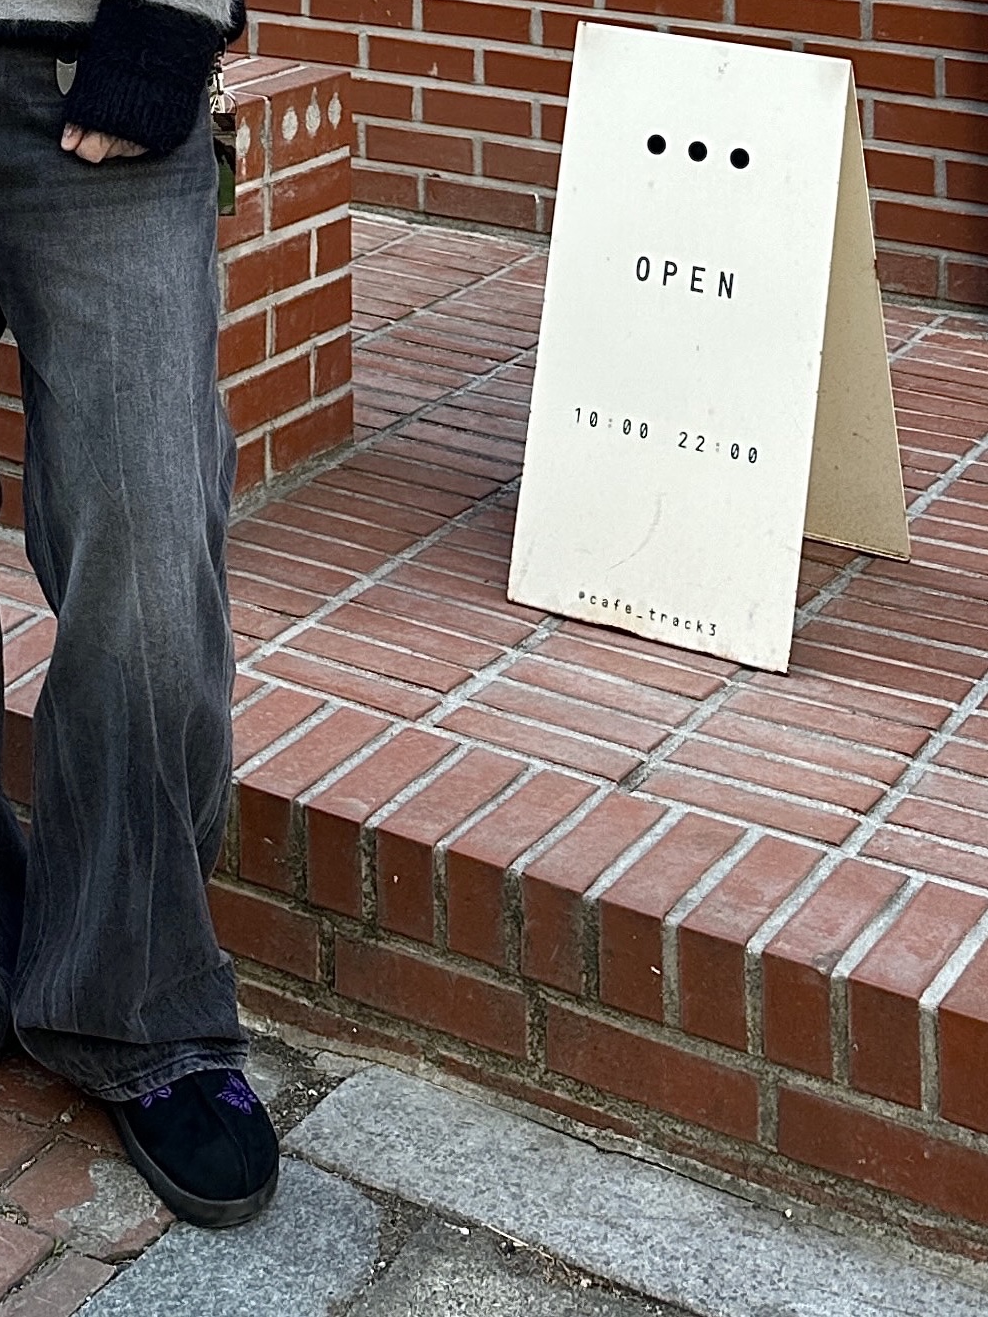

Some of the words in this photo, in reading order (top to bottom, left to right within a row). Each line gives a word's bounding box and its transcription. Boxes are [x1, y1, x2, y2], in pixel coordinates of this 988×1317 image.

[636, 256, 734, 299] OPEN
[575, 408, 648, 439] 10:00
[678, 431, 758, 464] 22:00
